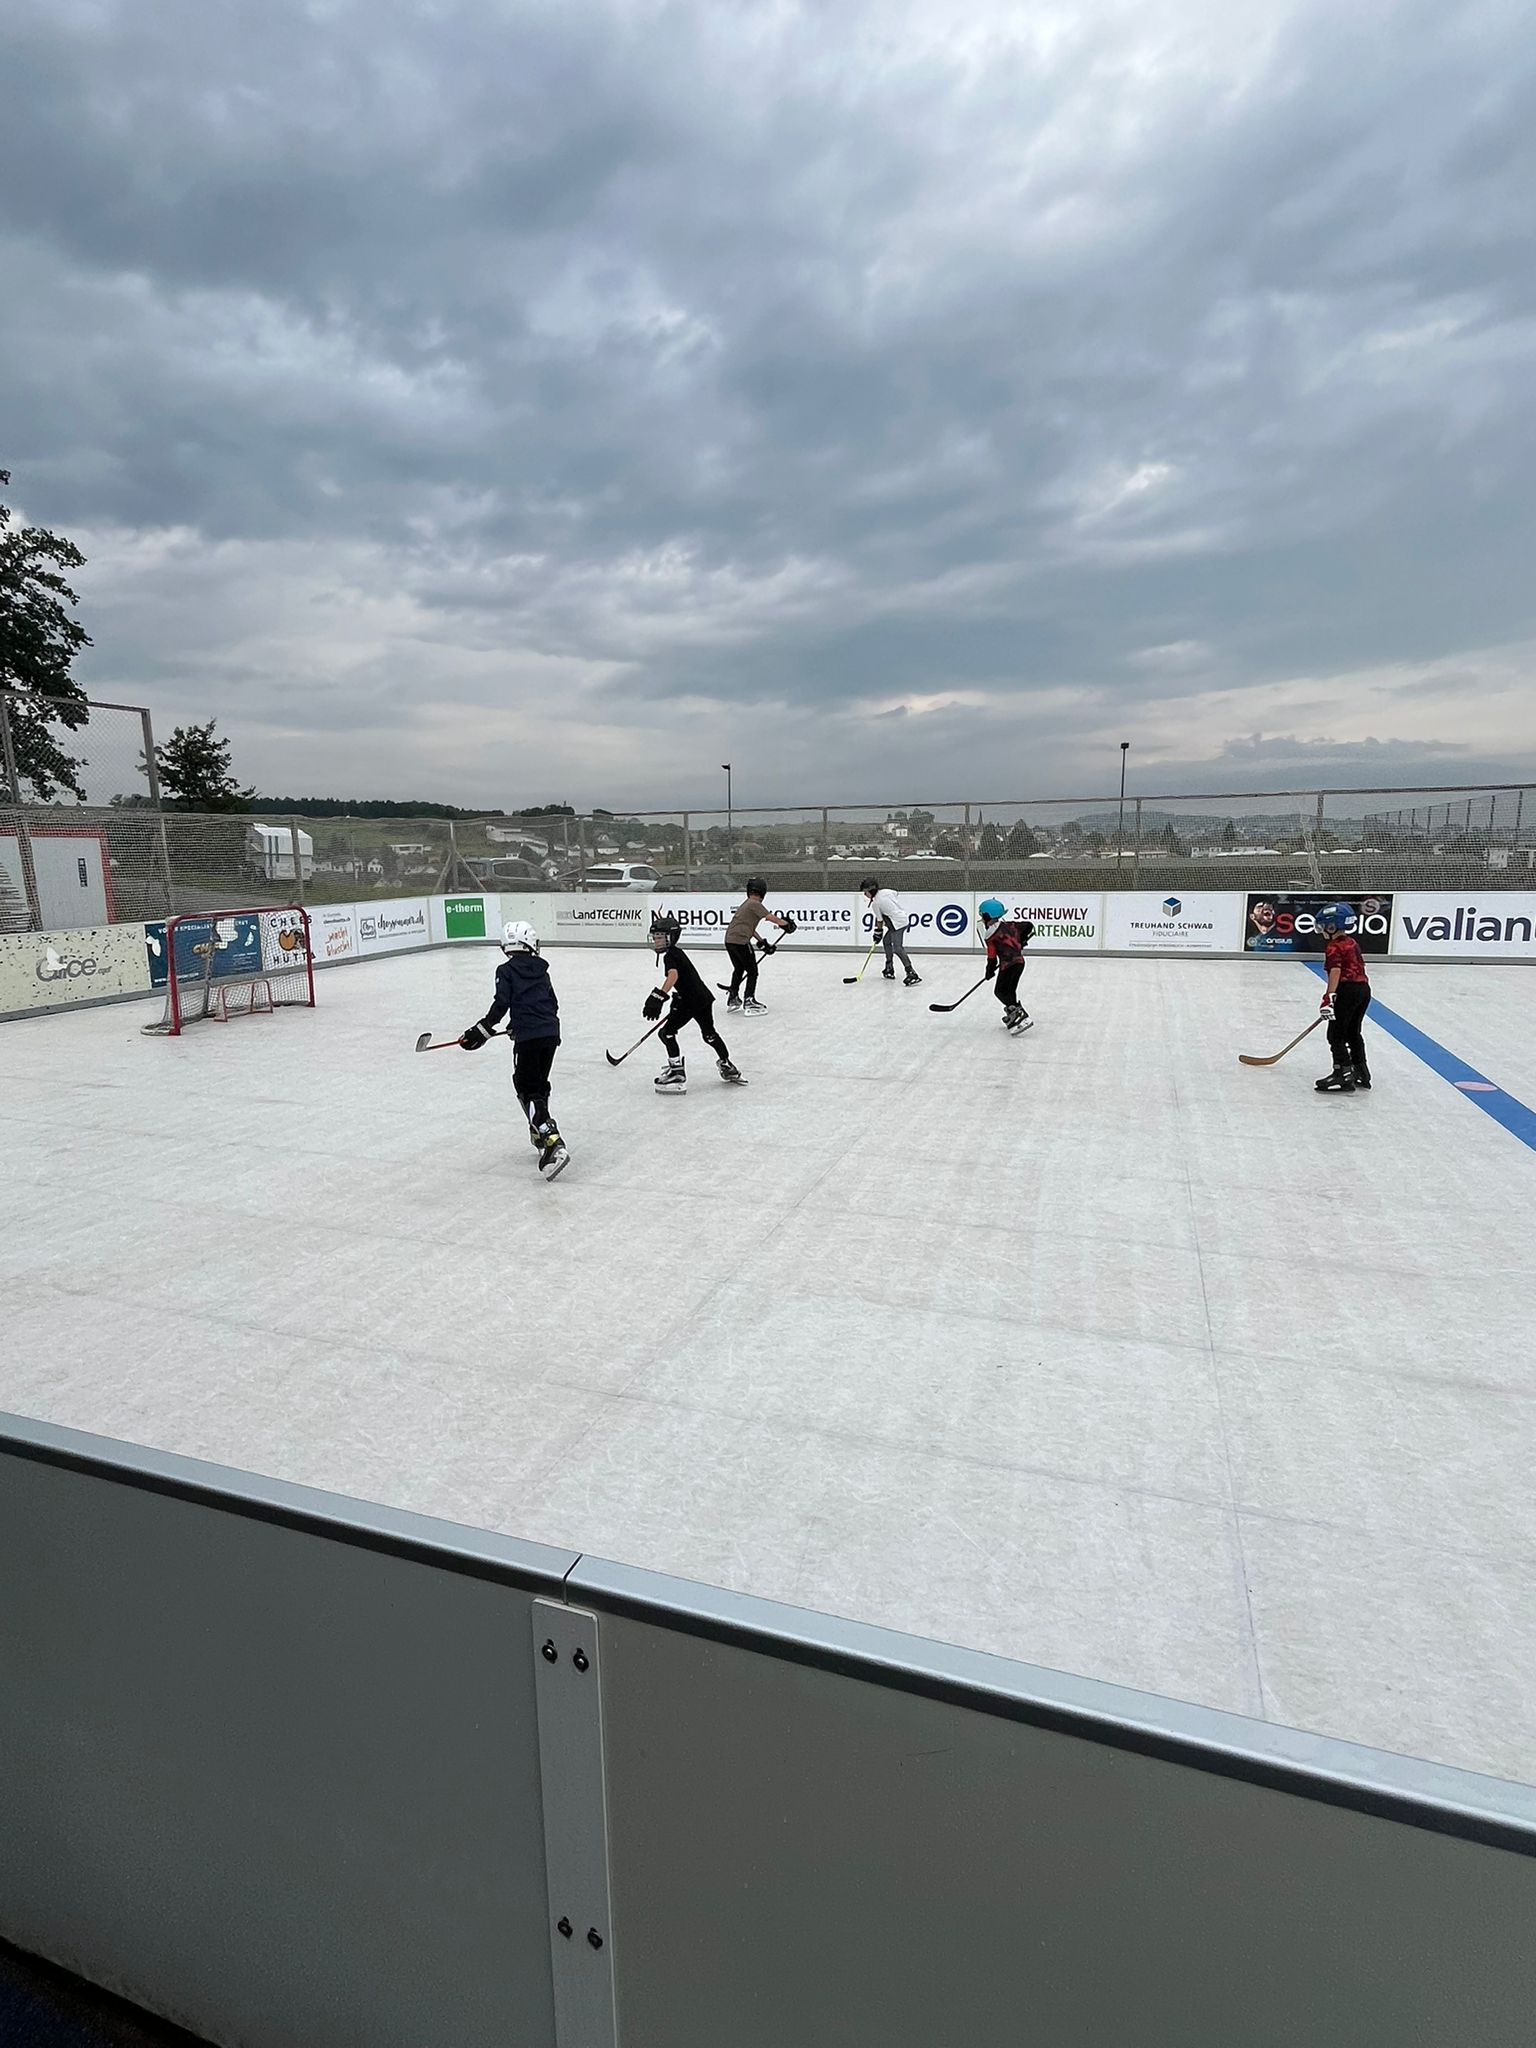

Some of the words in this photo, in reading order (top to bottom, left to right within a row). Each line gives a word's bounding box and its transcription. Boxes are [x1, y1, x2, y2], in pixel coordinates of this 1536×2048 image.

[446, 903, 483, 914] e-therm
[1014, 907, 1088, 920] SCHNEUWLY
[651, 910, 738, 926] NABHOL
[769, 909, 851, 922] ocurare
[862, 912, 933, 932] gpe
[1130, 922, 1175, 930] TREUHAND
[1177, 922, 1214, 930] SCHWAB
[1402, 907, 1536, 942] valian
[1033, 925, 1095, 938] ARTENBAU
